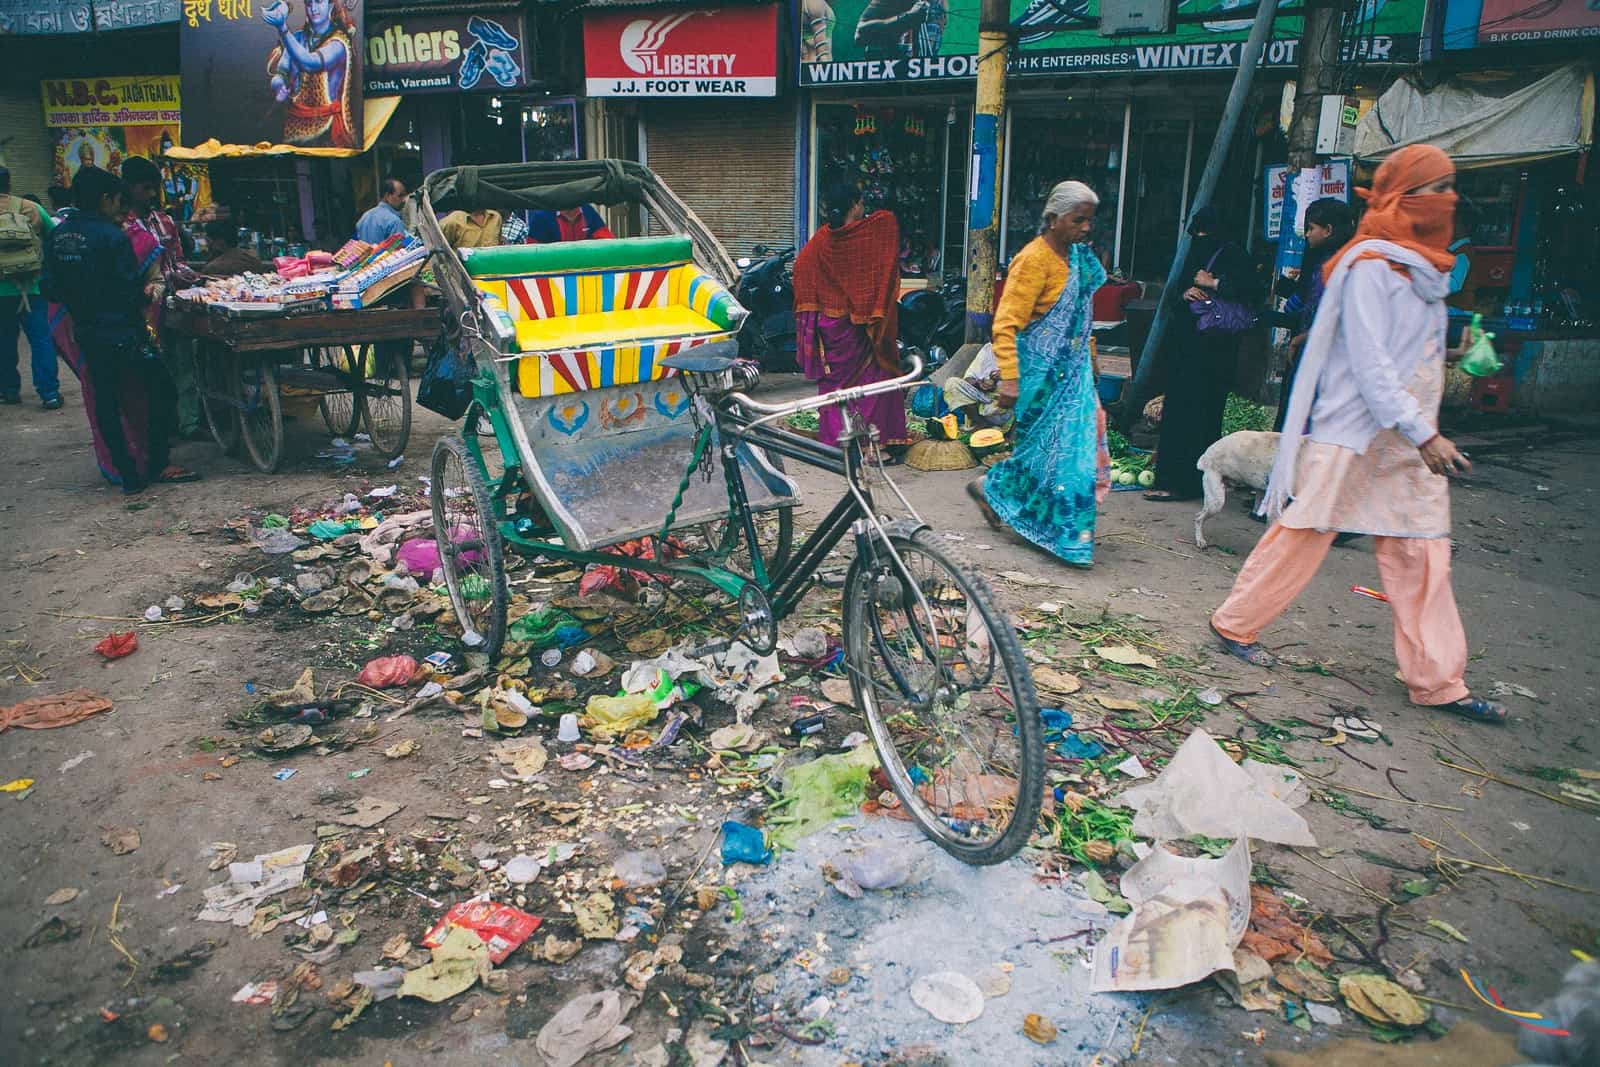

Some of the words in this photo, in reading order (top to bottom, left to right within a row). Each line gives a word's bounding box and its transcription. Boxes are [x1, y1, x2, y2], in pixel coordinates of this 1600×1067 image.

[1511, 31, 1541, 41] COLD
[1544, 28, 1578, 39] DRINK
[365, 25, 460, 65] others
[653, 54, 736, 75] LIBERTY
[1018, 57, 1027, 69] H
[1030, 57, 1039, 68] K
[1042, 53, 1129, 67] ENTERPRISES
[1136, 43, 1237, 68] WINTEX
[808, 60, 899, 82] WINTEX
[369, 80, 399, 90] Ghat,
[401, 76, 451, 88] Varanasi
[613, 81, 640, 93] J.J.
[646, 81, 690, 93] FOOT
[695, 81, 746, 93] WEAR
